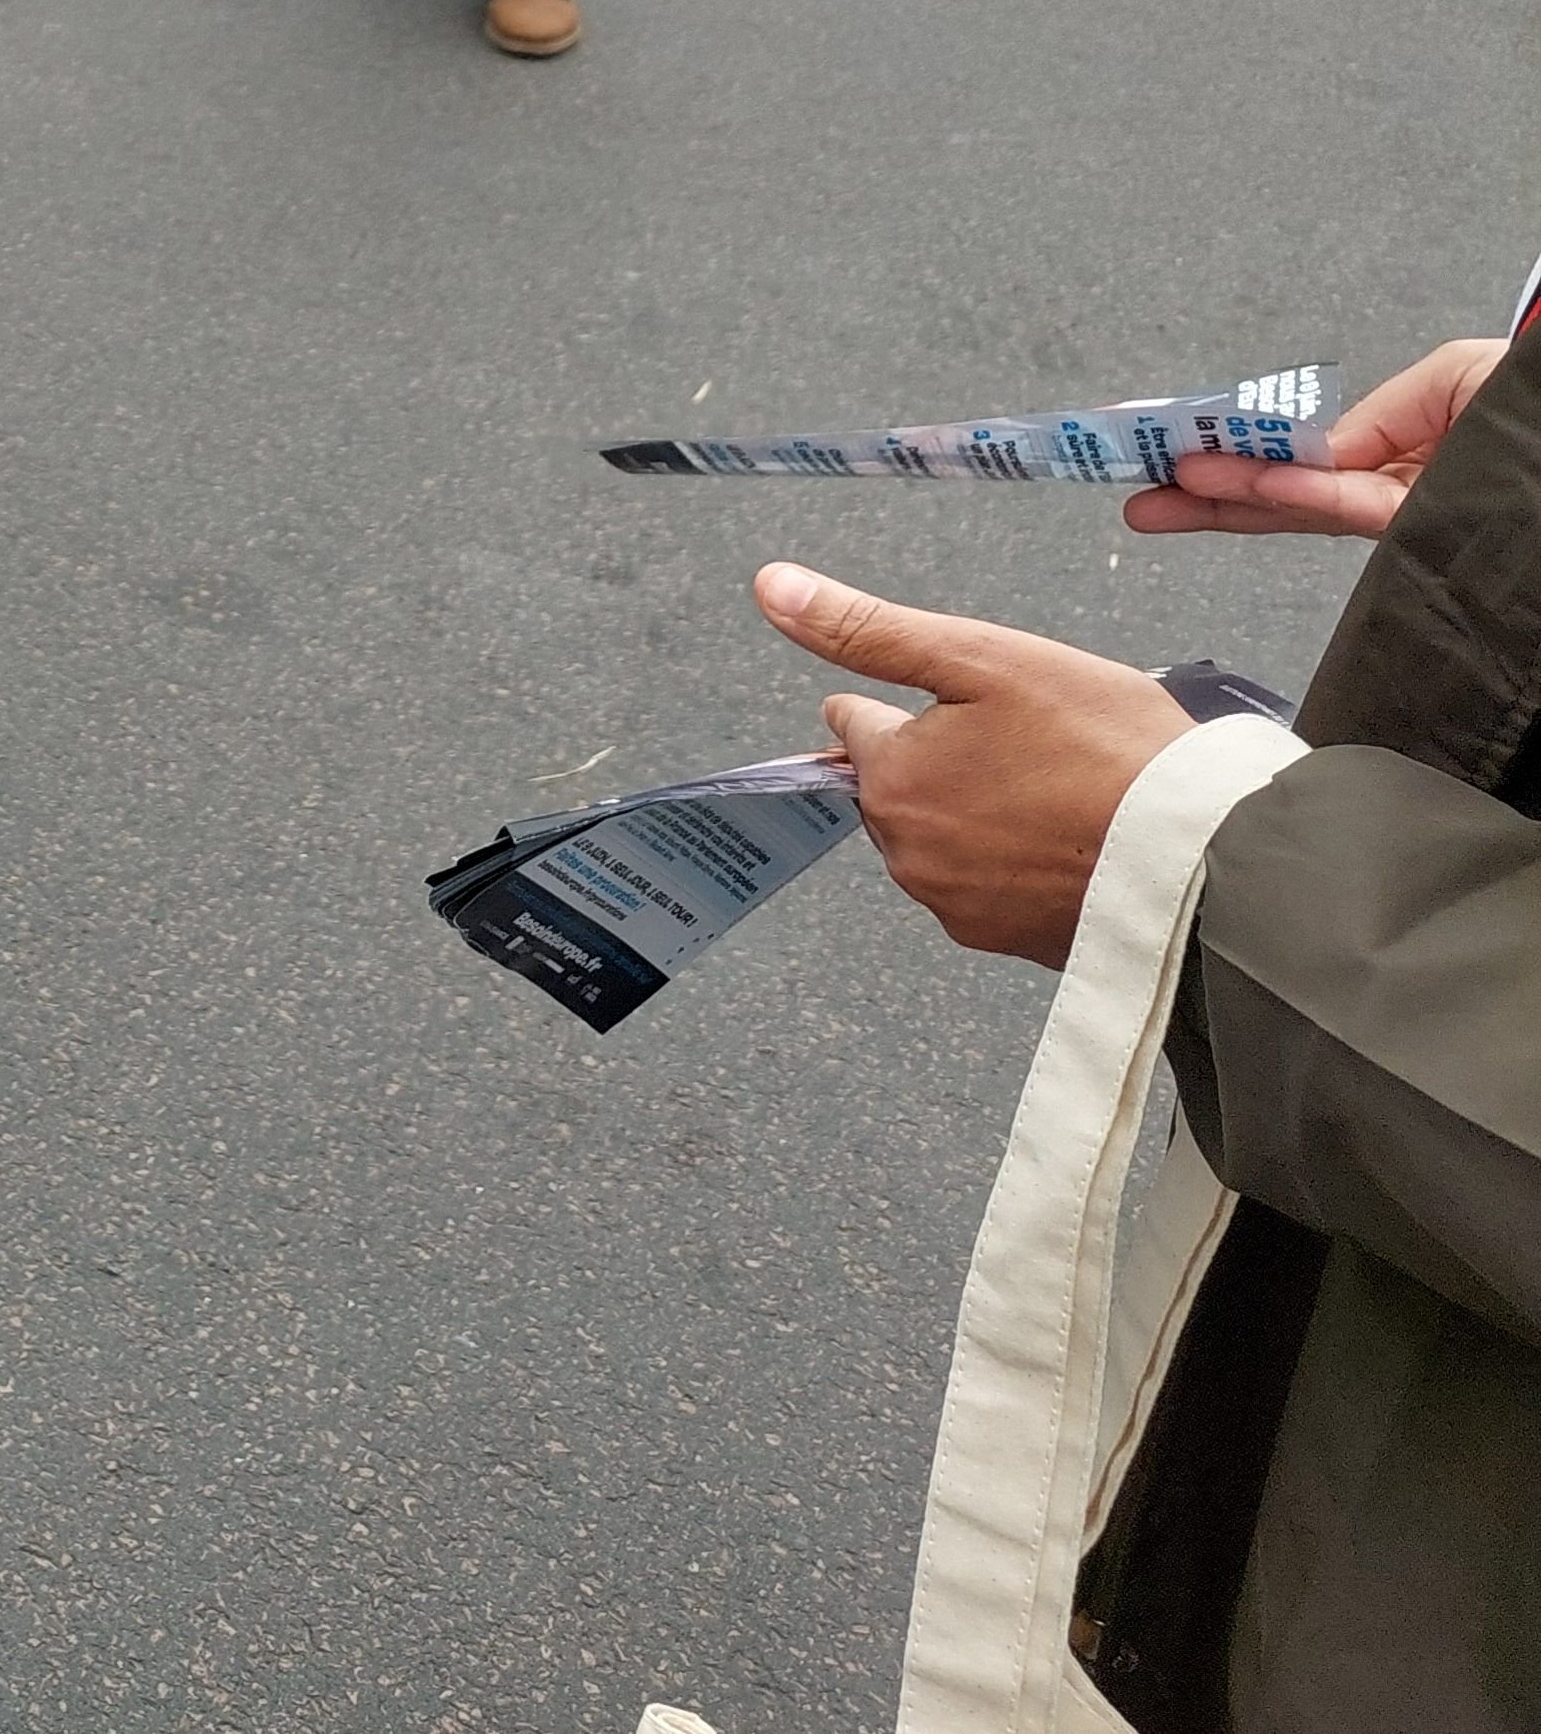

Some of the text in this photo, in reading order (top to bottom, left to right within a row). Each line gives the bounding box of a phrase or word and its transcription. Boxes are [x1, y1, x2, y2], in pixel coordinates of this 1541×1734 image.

[1061, 421, 1079, 432] 2
[1193, 416, 1219, 431] la
[1225, 416, 1253, 437] de
[1254, 418, 1293, 433] 5
[973, 430, 990, 440] 3
[1134, 428, 1149, 441] et
[1150, 426, 1169, 449] Être
[1083, 433, 1101, 459] Faire
[513, 911, 603, 973] Besoindeurope.fr
